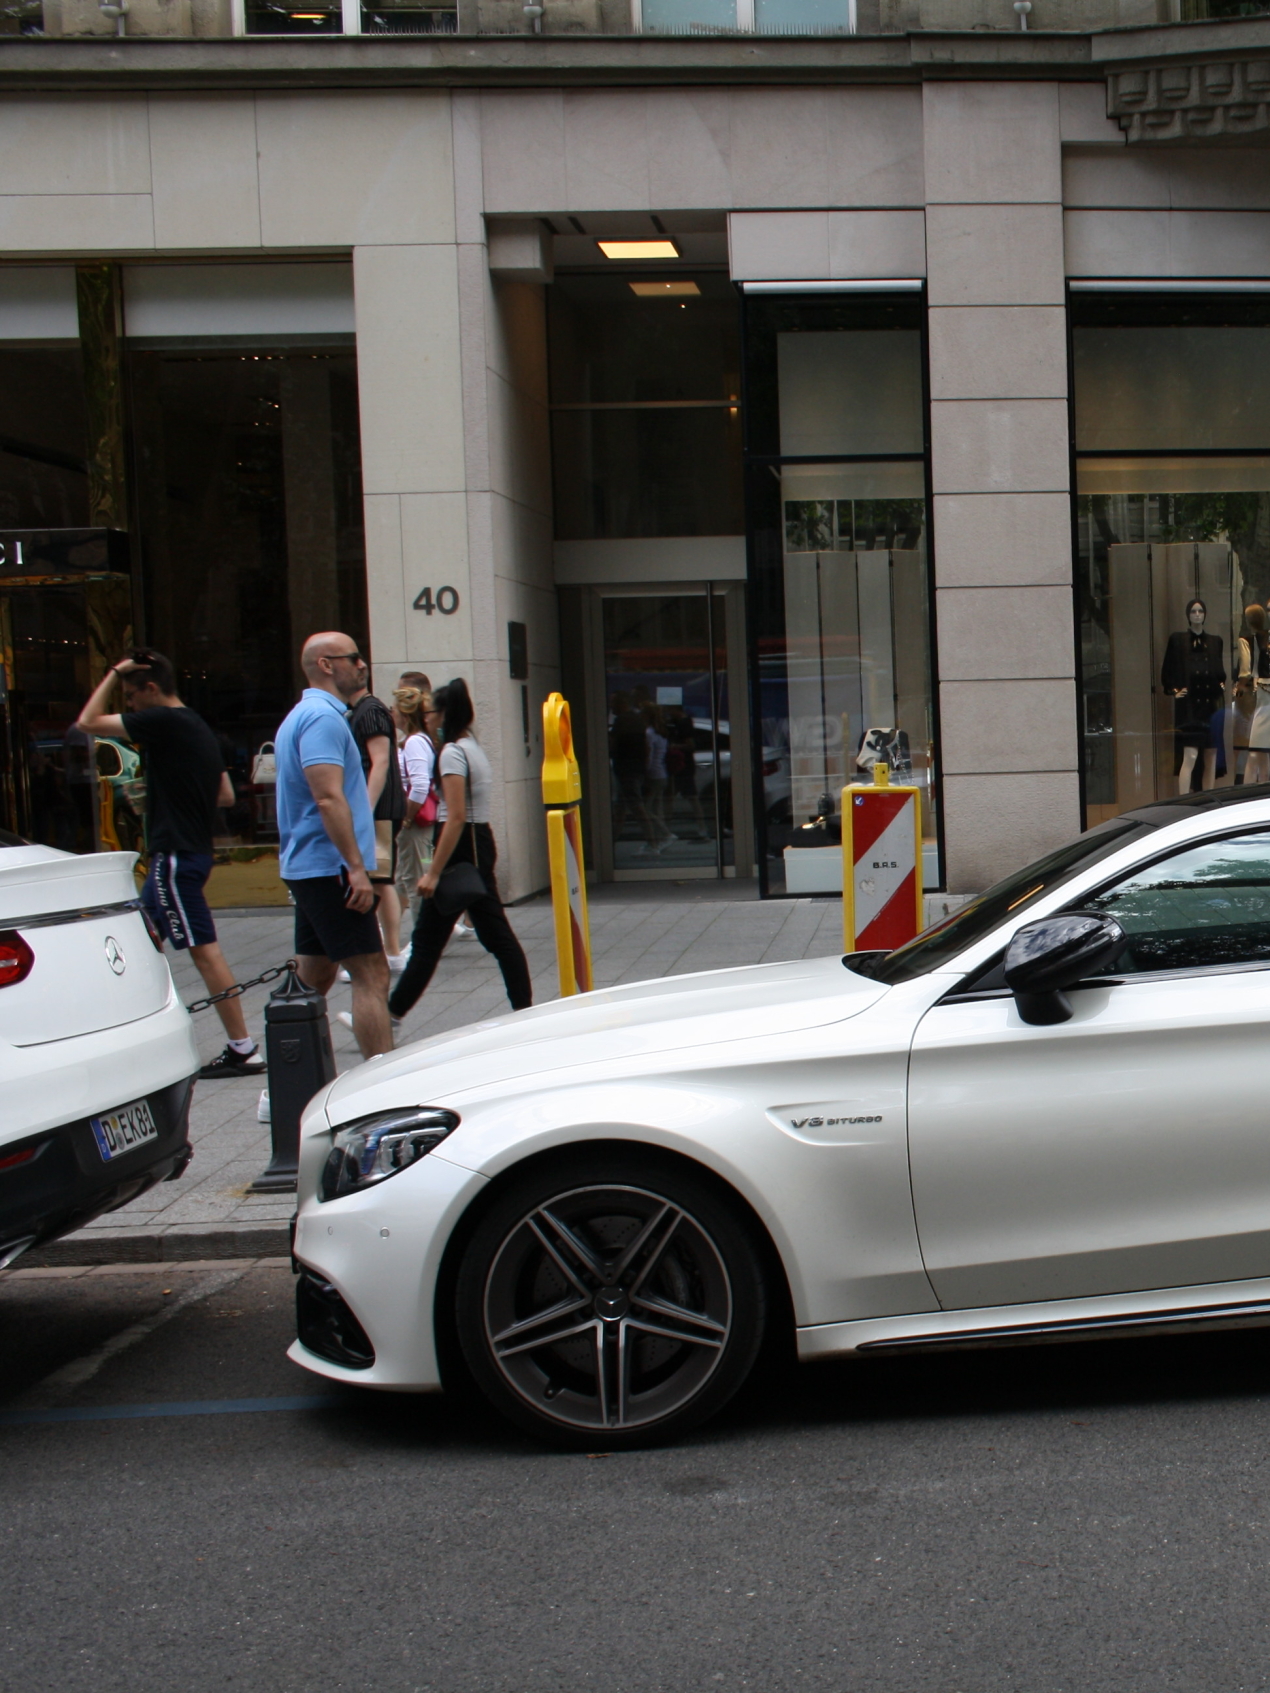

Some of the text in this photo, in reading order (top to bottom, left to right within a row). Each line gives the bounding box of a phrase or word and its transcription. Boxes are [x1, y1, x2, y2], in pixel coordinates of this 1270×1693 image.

[413, 586, 460, 615] 40
[166, 910, 184, 940] Club
[827, 1115, 883, 1125] BITURBO
